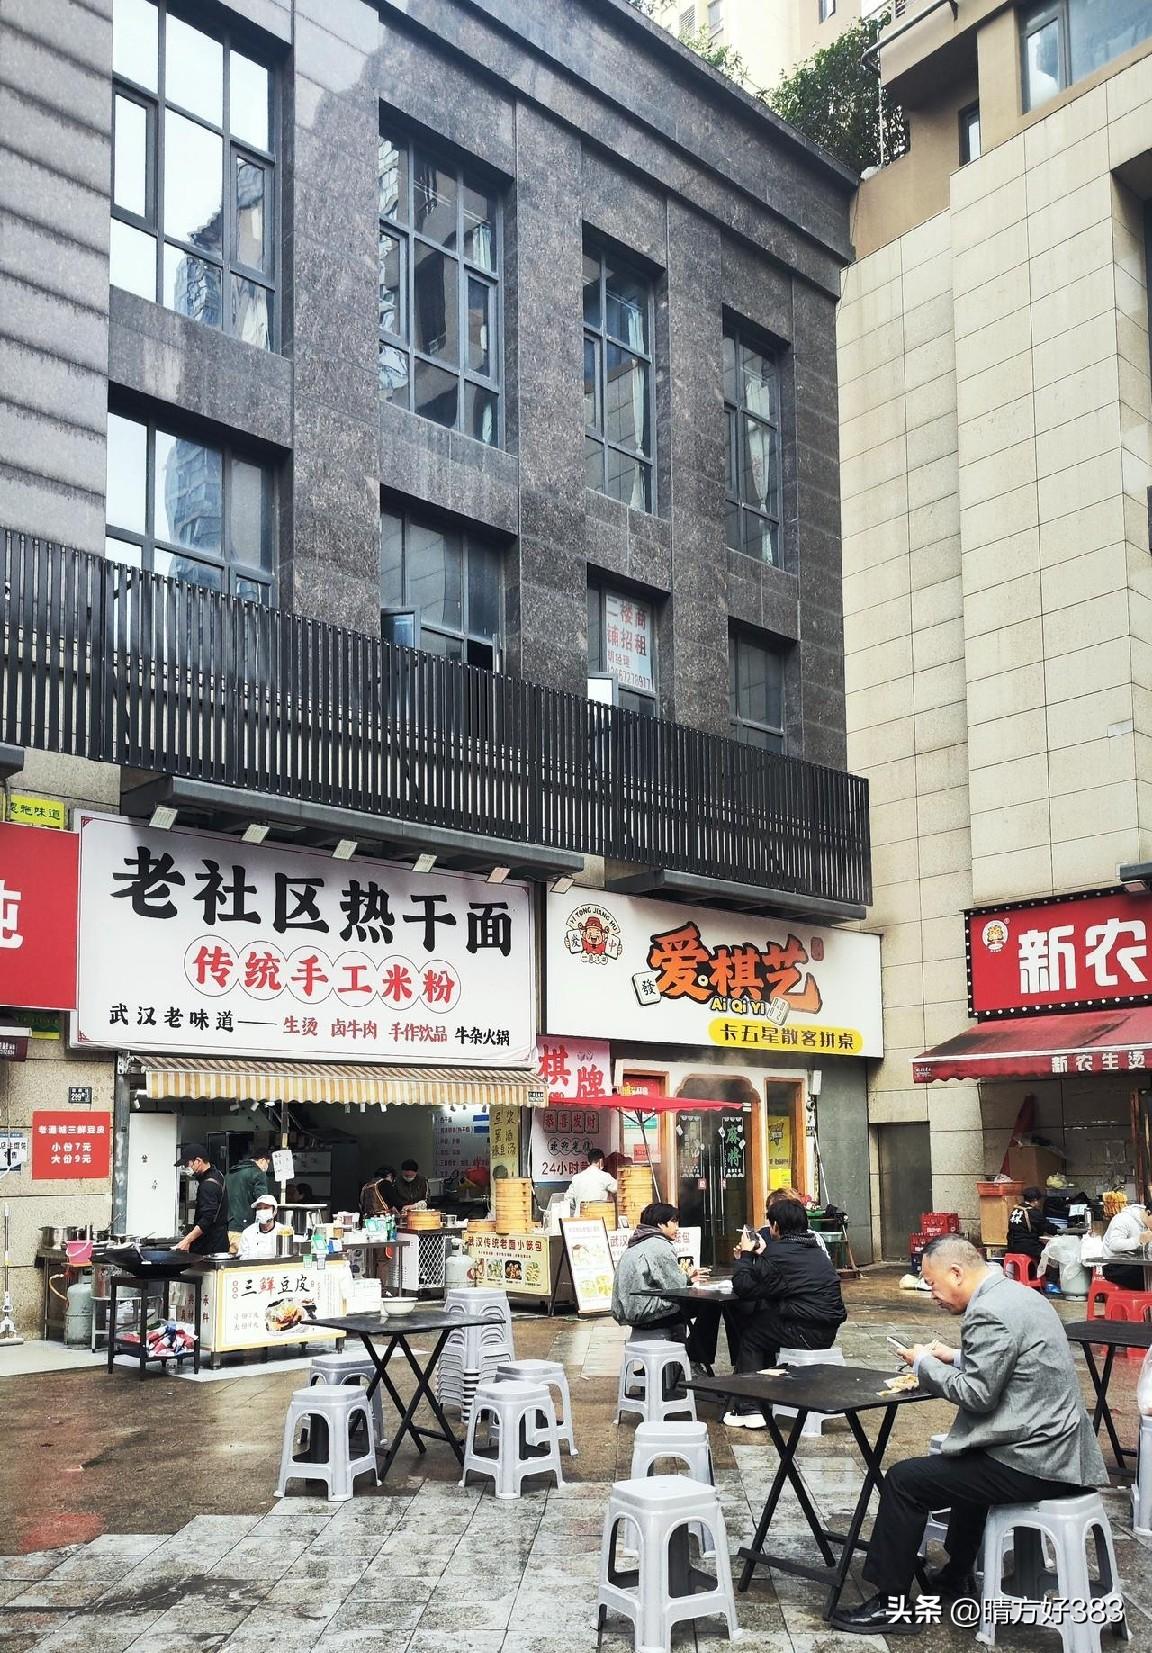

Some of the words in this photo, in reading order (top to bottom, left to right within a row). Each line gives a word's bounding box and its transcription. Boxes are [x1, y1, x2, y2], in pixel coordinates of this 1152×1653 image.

[110, 846, 513, 957] 老社区热干面
[1018, 918, 1148, 994] 新农
[193, 946, 456, 1003] 传统手工米粉
[711, 997, 727, 1012] Ai
[732, 999, 748, 1015] Qi
[283, 1016, 319, 1037] 生烫
[331, 1018, 378, 1040] 卤牛肉
[388, 1020, 448, 1043] 手作饮品
[455, 1026, 511, 1047] 牛杂火锅
[719, 1023, 854, 1050] 卡五星散客拼桌
[1051, 1050, 1146, 1073] 新农生烫
[50, 1154, 92, 1164] 大份9元
[51, 1142, 92, 1152] 小份7元
[241, 1276, 311, 1298] 三鲜豆皮
